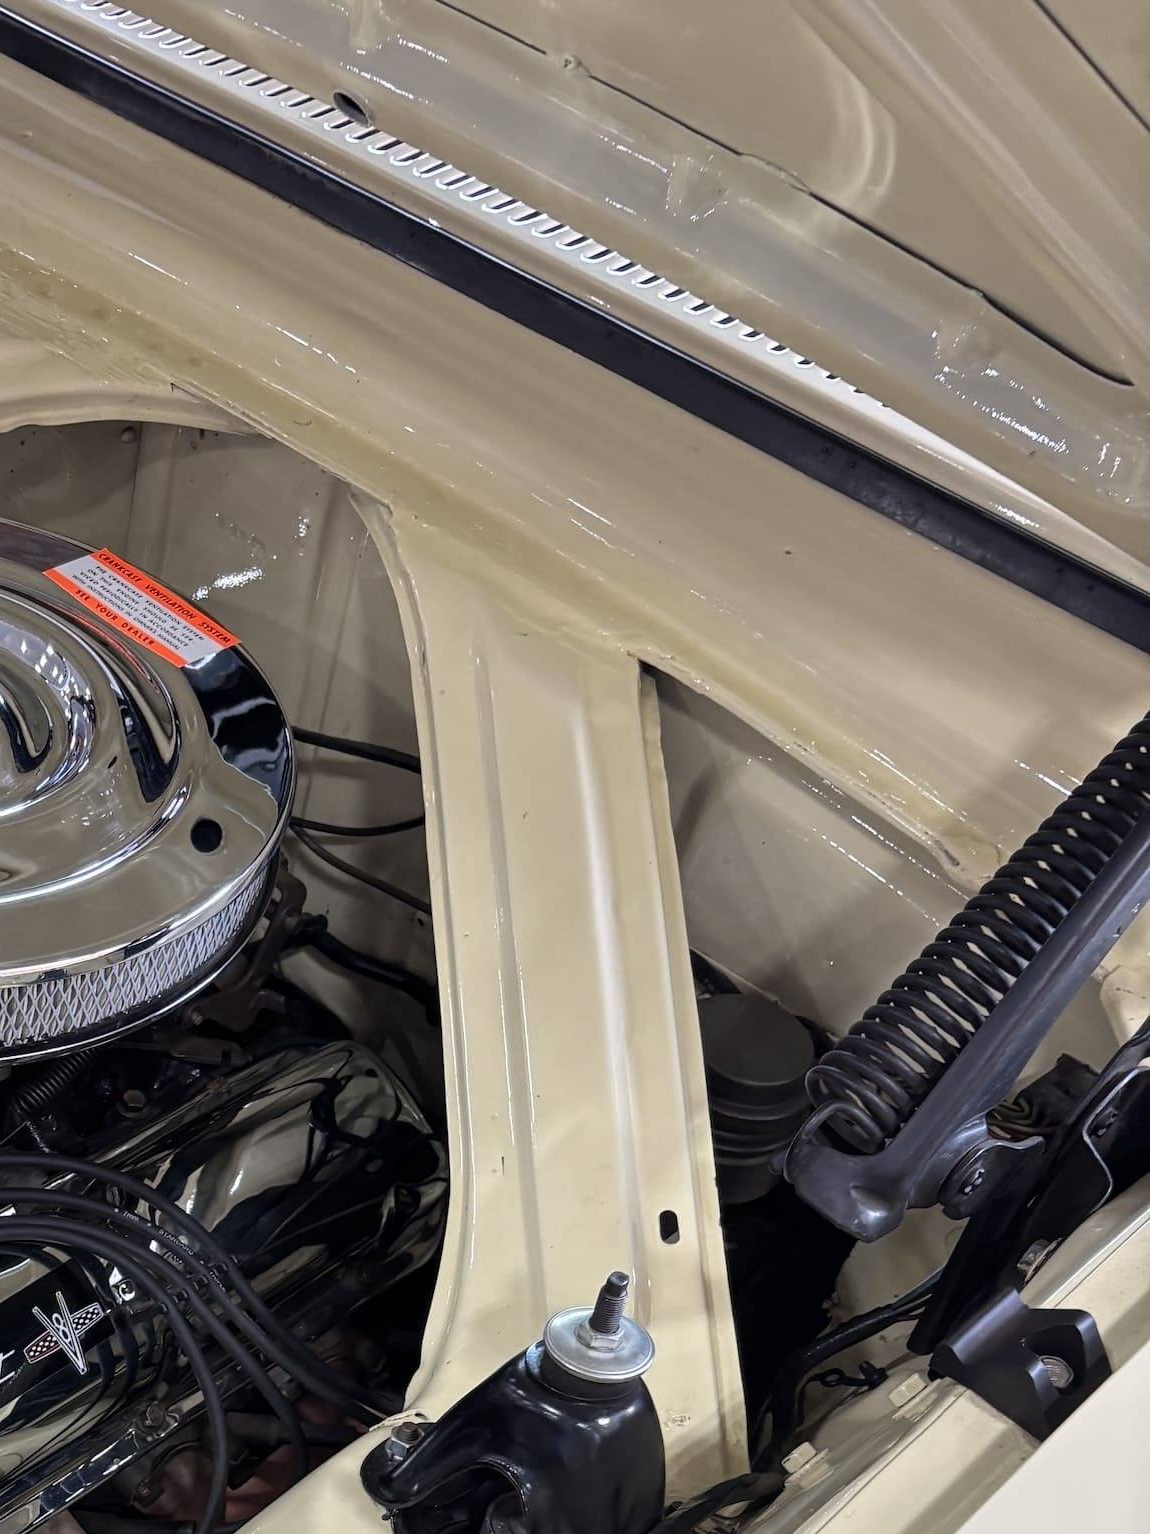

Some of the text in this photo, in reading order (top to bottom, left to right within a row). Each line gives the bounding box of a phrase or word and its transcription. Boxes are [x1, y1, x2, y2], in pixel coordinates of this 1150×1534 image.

[72, 574, 86, 585] WITH
[87, 585, 124, 611] INSTRUCTIONS
[158, 634, 180, 650] MANUAL
[75, 589, 155, 645] SEE YOUR DEALER
[98, 553, 231, 644] CRANKCASE VENTILATION SYSTEM
[100, 586, 139, 612] PERIODICALLY
[148, 619, 189, 647] ACCORDANCE
[101, 577, 112, 586] THIS
[117, 588, 139, 604] ENGINE
[143, 607, 167, 623] SHOULD
[108, 575, 143, 598] CRANKCASE
[146, 600, 180, 625] VENTILATION
[183, 625, 205, 640] SYSTEM
